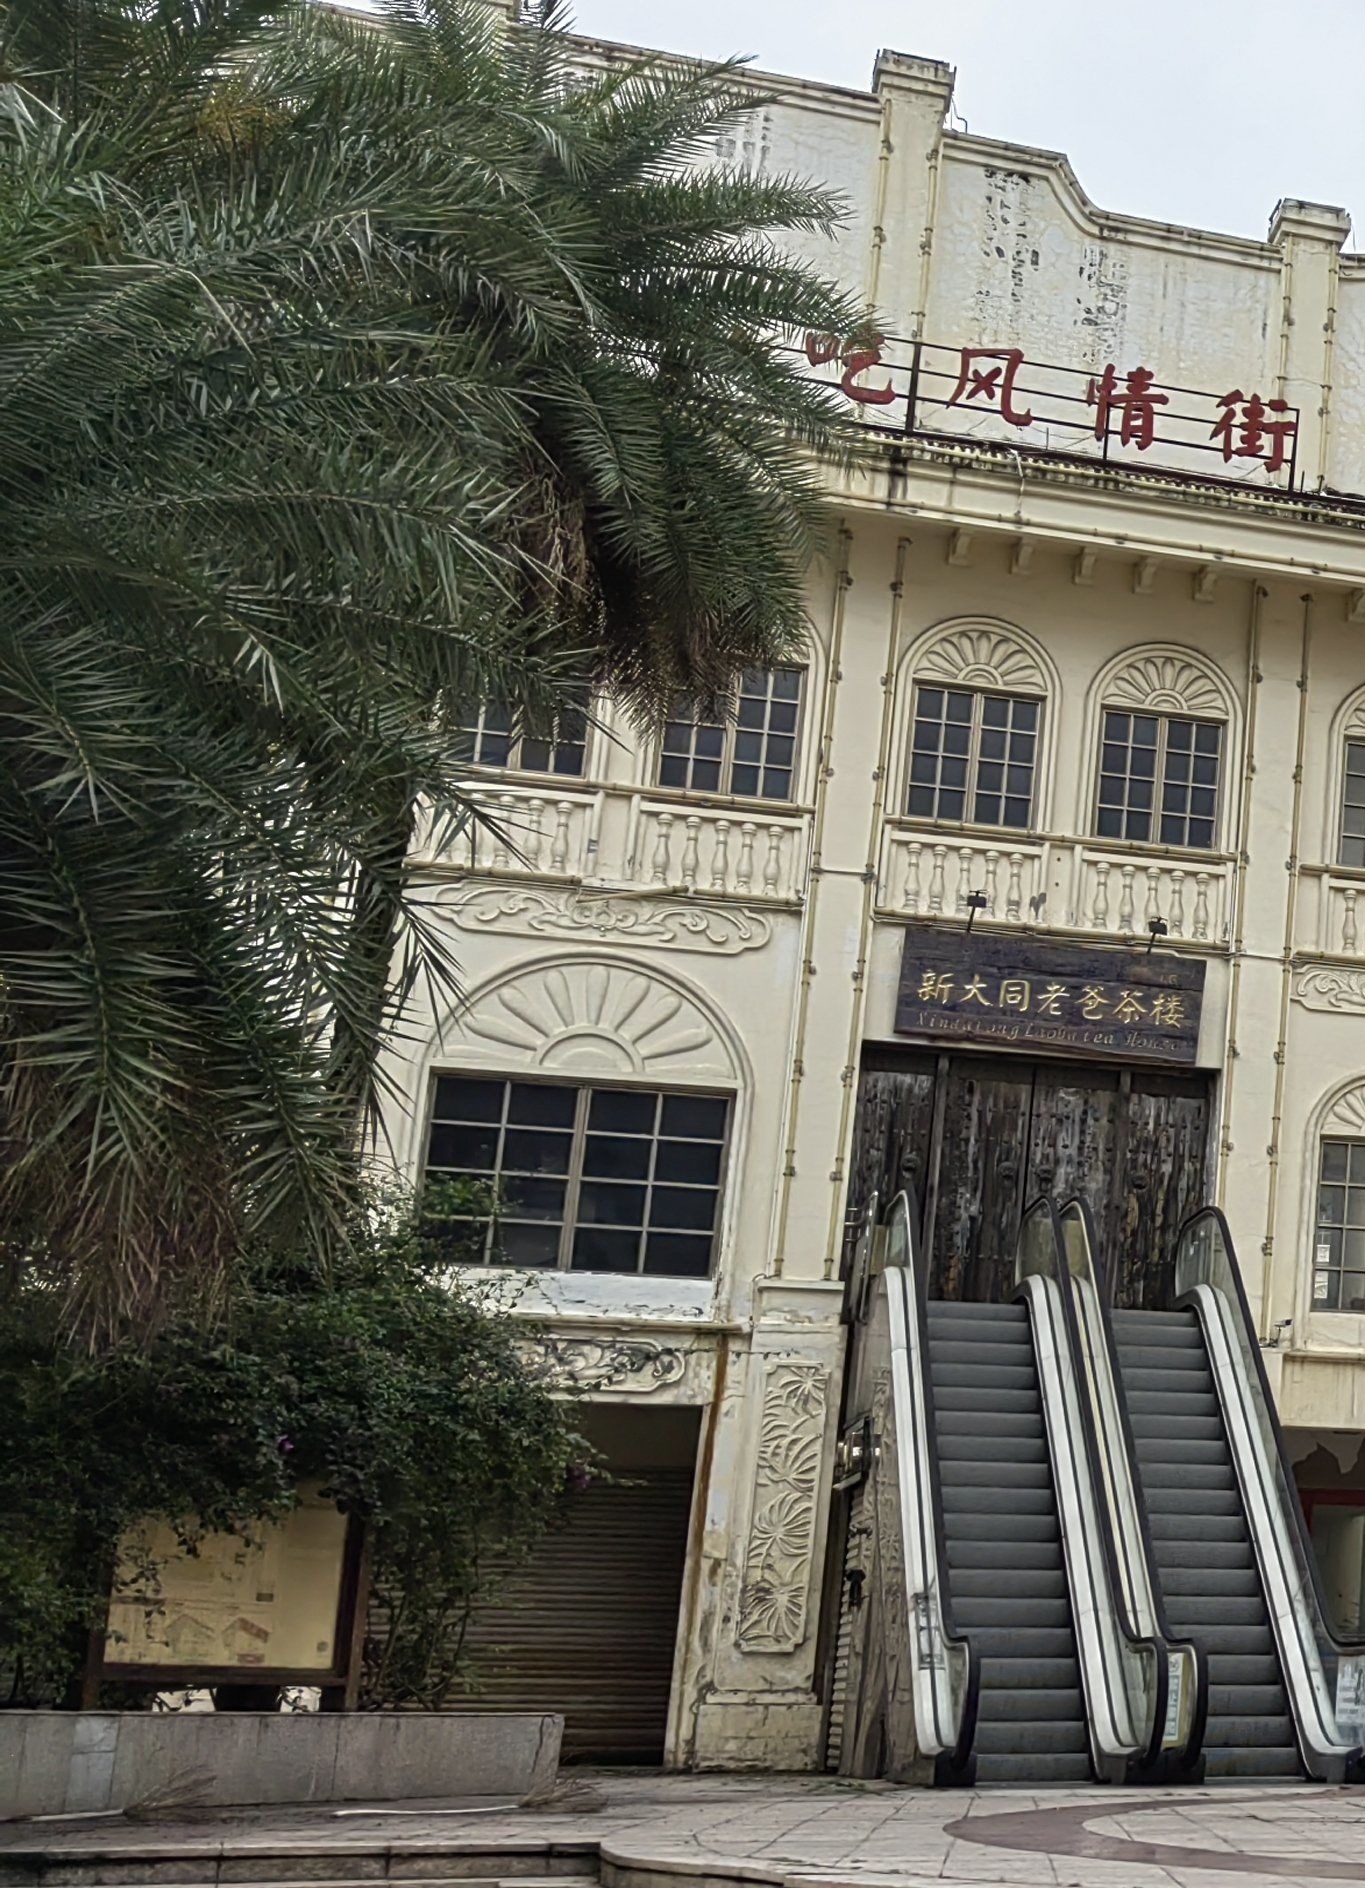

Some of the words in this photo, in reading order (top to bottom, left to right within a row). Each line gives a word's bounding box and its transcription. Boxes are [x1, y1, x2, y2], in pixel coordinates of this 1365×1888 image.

[917, 968, 1186, 1029] 新大同老爸茶楼
